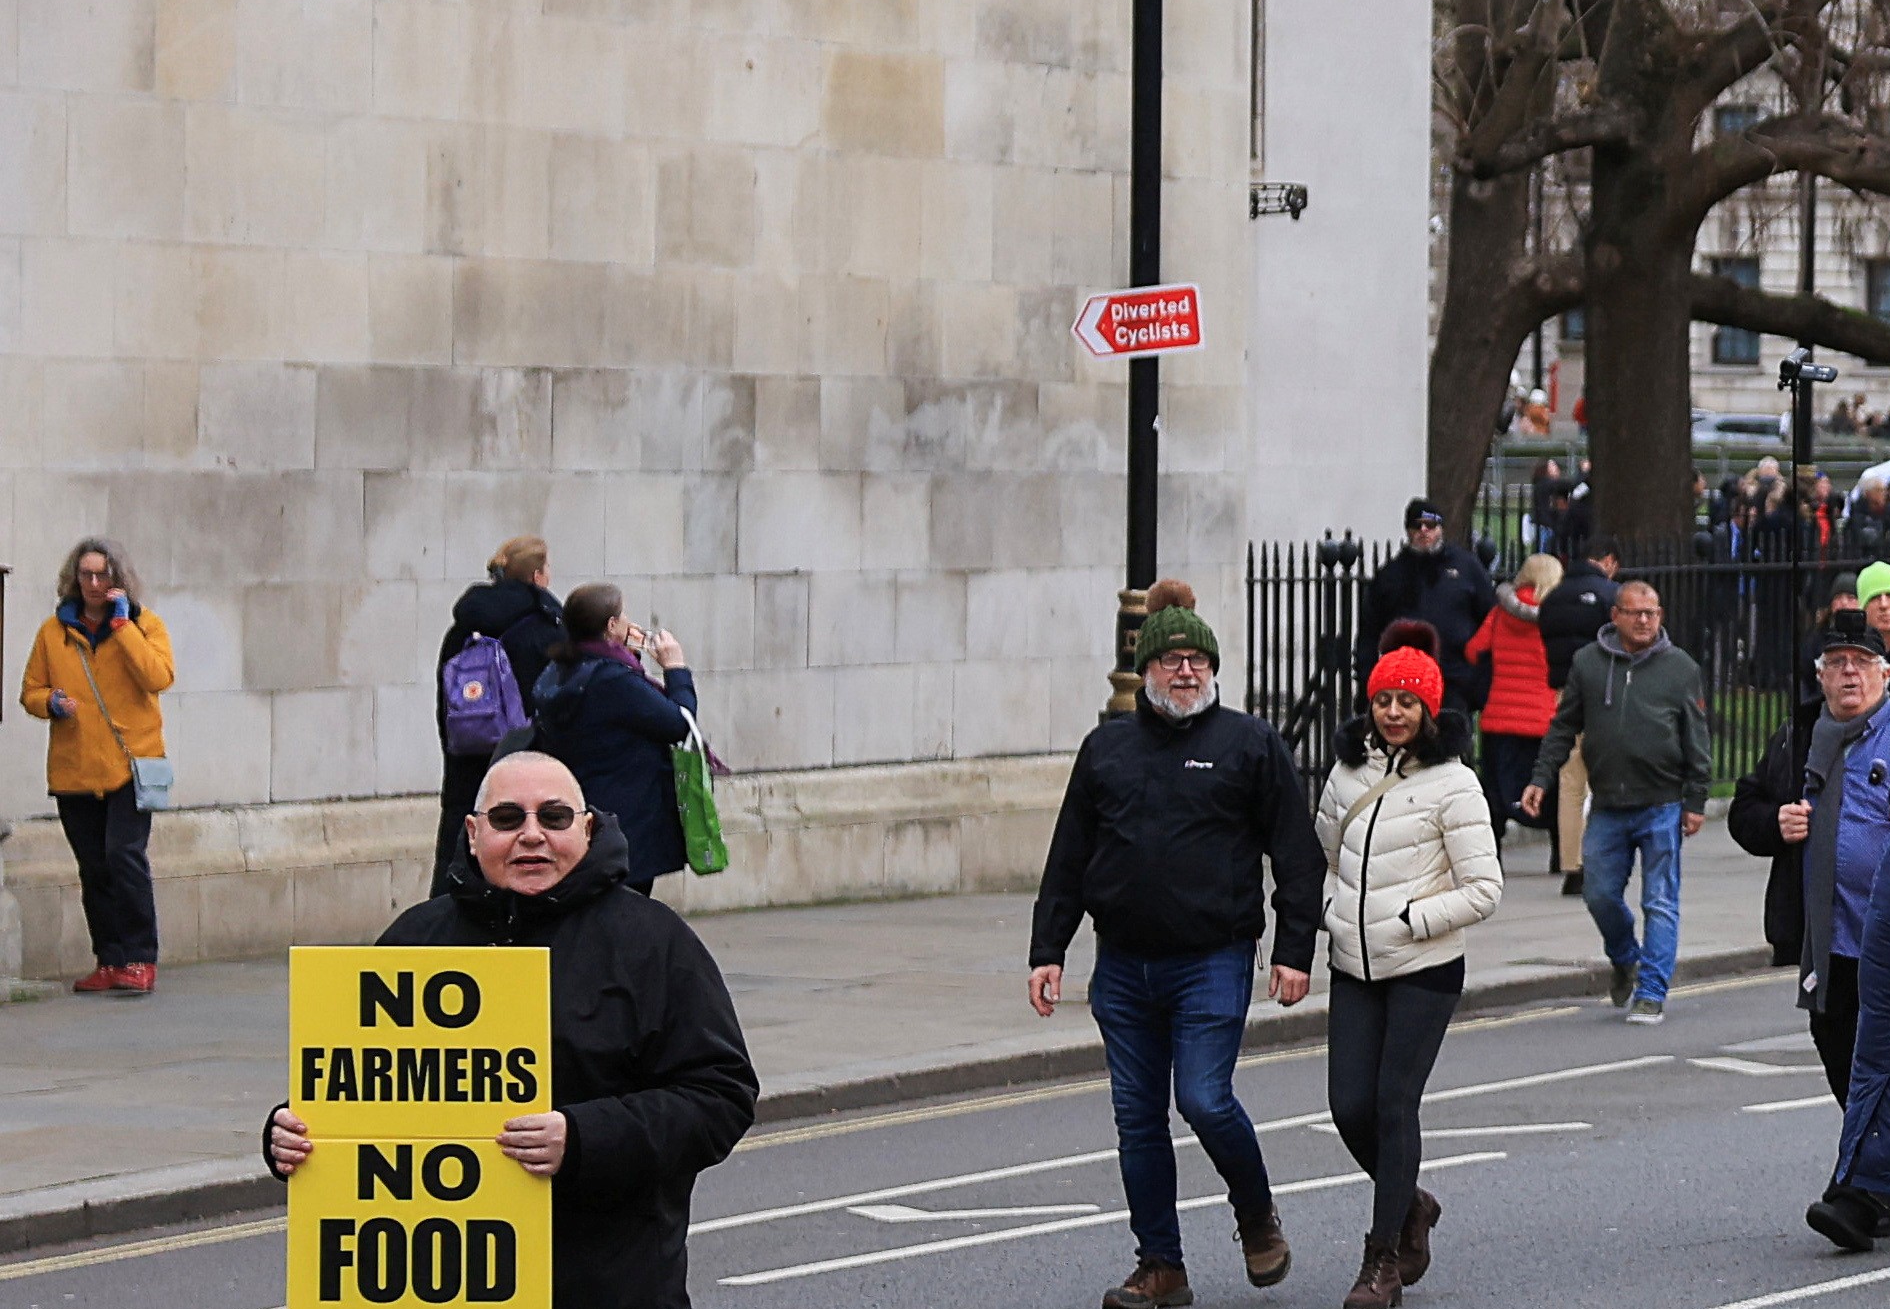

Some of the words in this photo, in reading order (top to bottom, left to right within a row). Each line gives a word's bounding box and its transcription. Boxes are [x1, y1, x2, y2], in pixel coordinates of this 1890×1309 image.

[1111, 296, 1190, 321] Diverted
[1114, 321, 1191, 346] Cyclists
[360, 971, 480, 1028] NO
[302, 1048, 537, 1103] FARMERS
[358, 1144, 480, 1201] NO
[320, 1218, 516, 1303] FOOD
